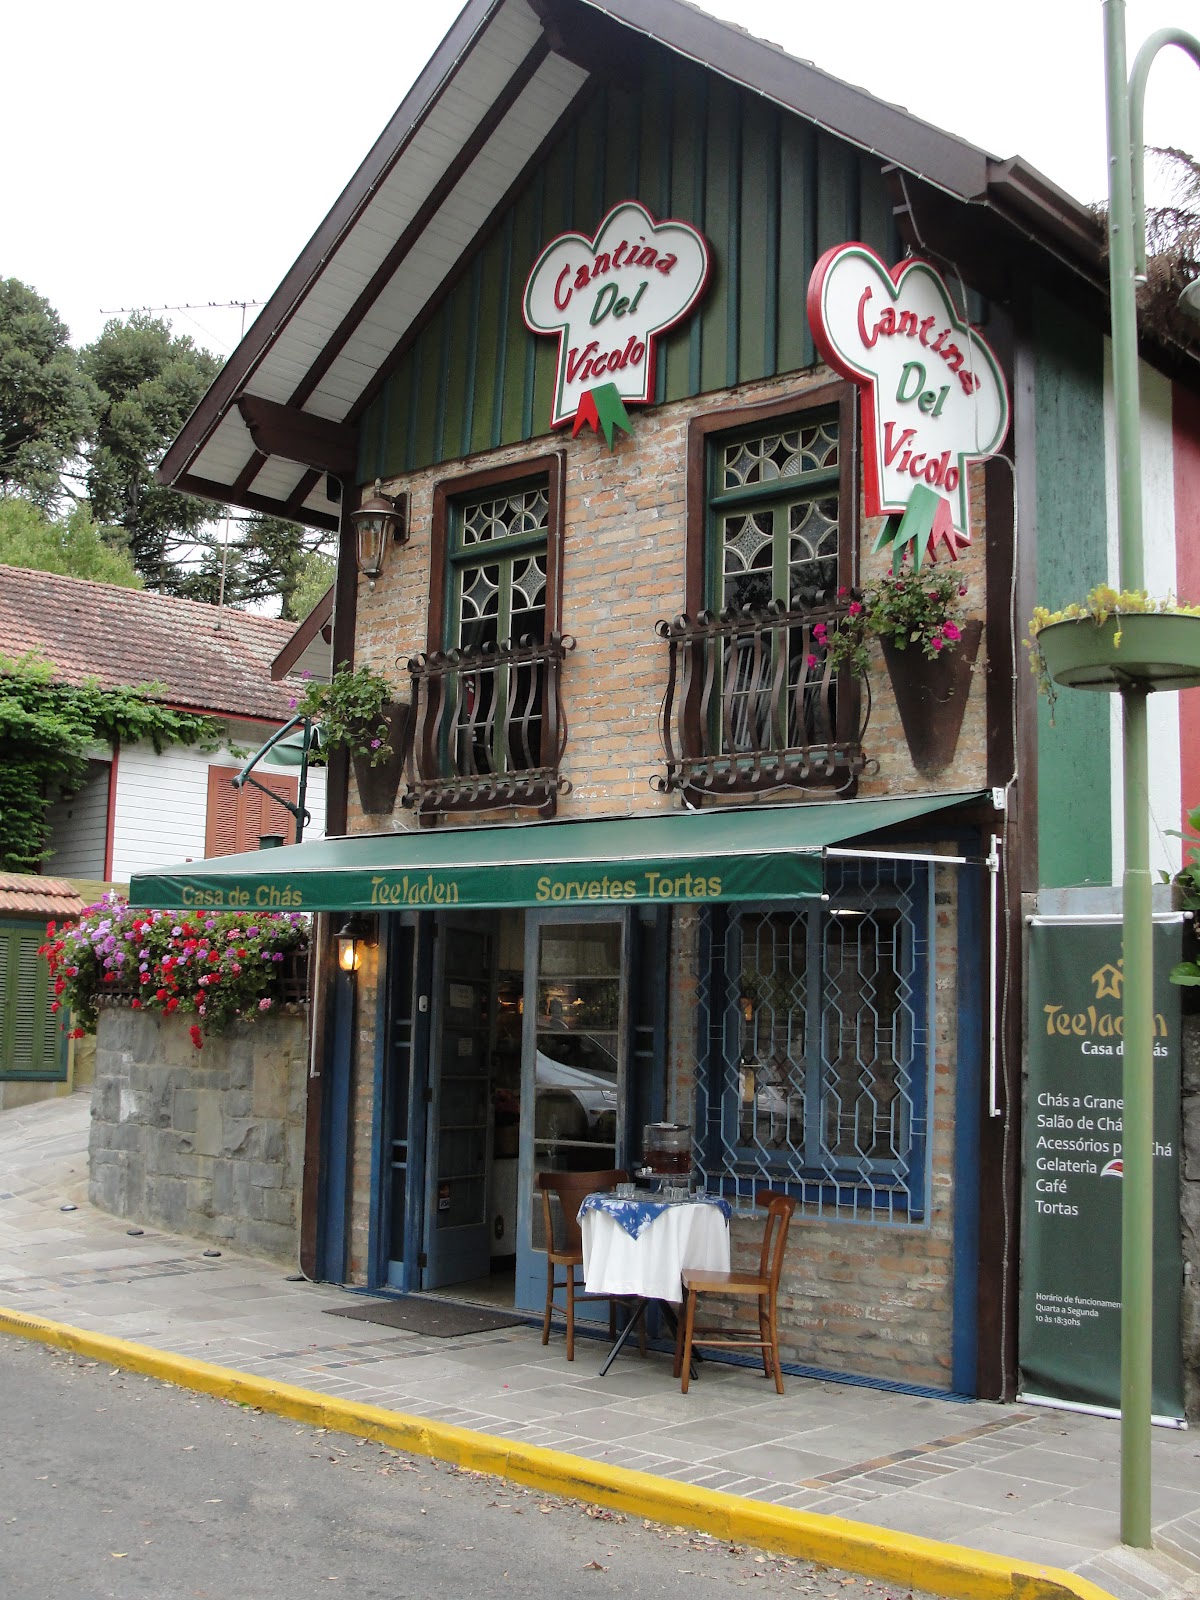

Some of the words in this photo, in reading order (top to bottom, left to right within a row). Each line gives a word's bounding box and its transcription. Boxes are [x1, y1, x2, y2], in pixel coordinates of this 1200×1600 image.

[554, 236, 678, 311] Cantina
[589, 281, 649, 326] Del
[857, 285, 981, 396] Cantina
[566, 335, 646, 385] Vicolo
[896, 361, 950, 417] Del
[883, 421, 960, 492] Vicolo
[182, 885, 224, 906] Casa
[227, 887, 250, 906] de
[255, 884, 303, 906] Chás
[371, 874, 459, 905] Teeladen
[535, 876, 637, 901] Sorvetes
[644, 872, 722, 898] Tortas
[1081, 1041, 1114, 1055] Casa
[1115, 1041, 1125, 1055] d
[1037, 1092, 1070, 1108] Chás
[1072, 1097, 1080, 1108] a
[1037, 1114, 1074, 1129] Salão
[1077, 1116, 1094, 1130] de
[1097, 1117, 1123, 1131] Chá
[1036, 1136, 1110, 1152] Acessórios
[1036, 1157, 1097, 1174] Gelateria
[1035, 1179, 1067, 1193] Café
[1035, 1200, 1079, 1215] Tortas
[1036, 1293, 1063, 1302] Horário
[1064, 1295, 1073, 1303] de
[1035, 1303, 1060, 1313] Quarta
[1067, 1307, 1099, 1317] Segunda
[1044, 1315, 1053, 1323] às
[1054, 1316, 1081, 1326] 18:30hs
